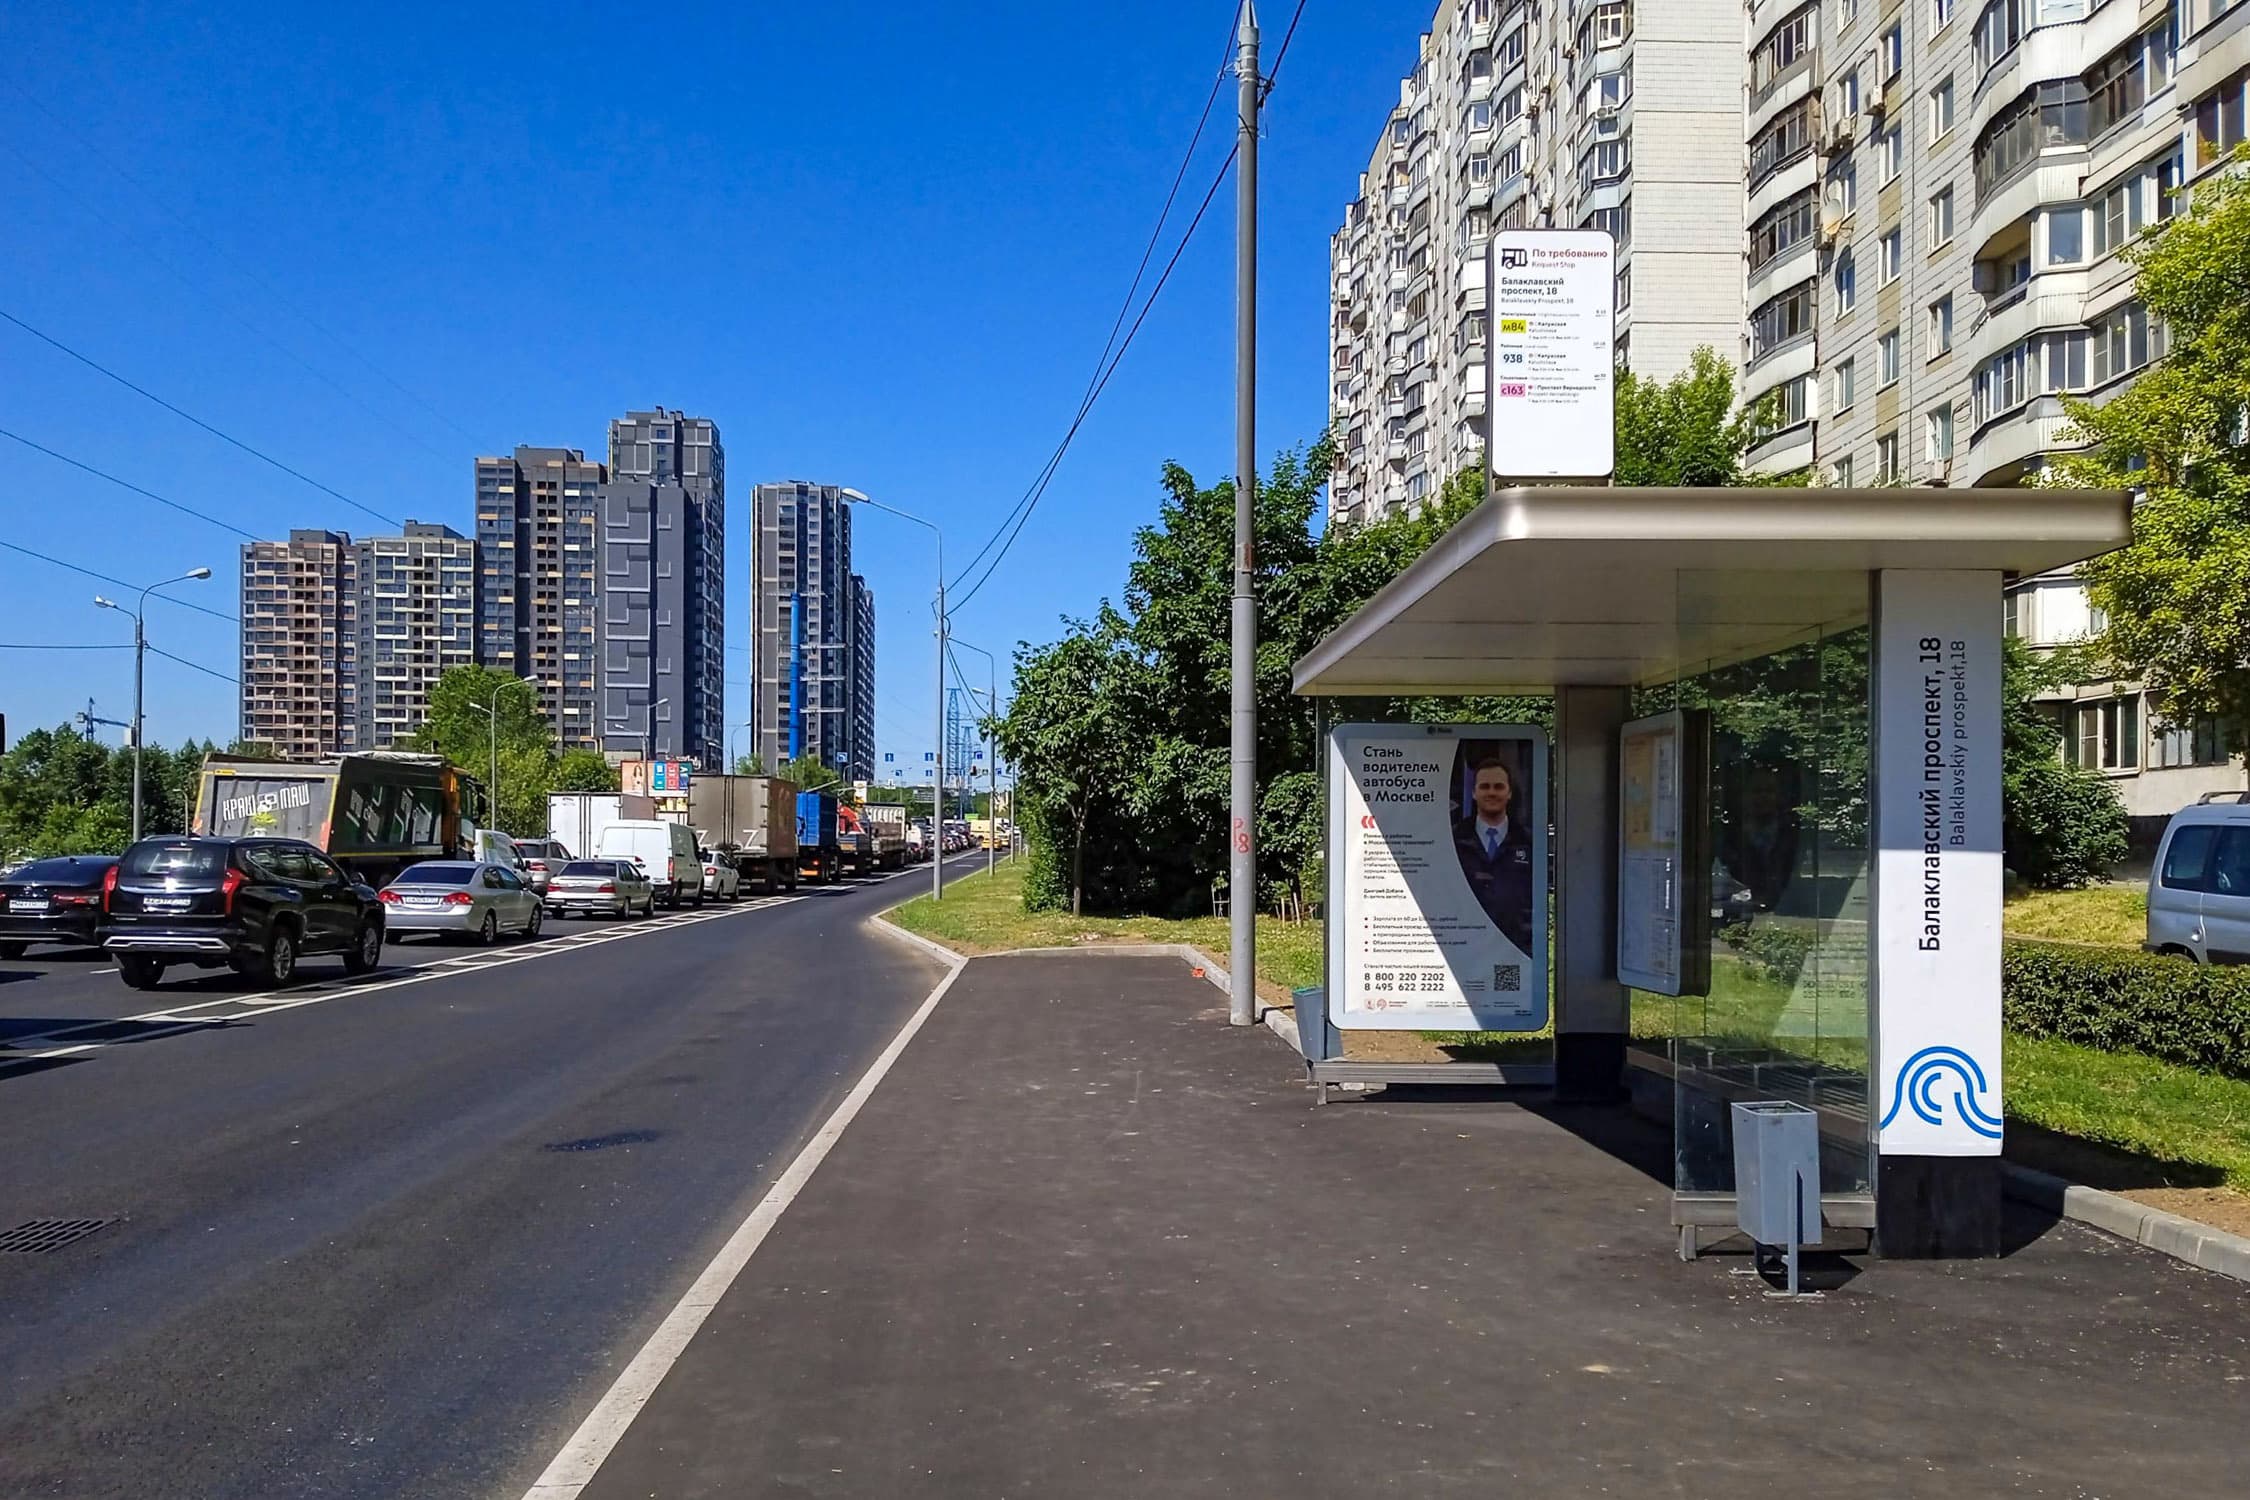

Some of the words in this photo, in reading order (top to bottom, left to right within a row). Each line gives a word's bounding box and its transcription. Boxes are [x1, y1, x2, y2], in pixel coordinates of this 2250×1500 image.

[1532, 249, 1546, 258] По
[1549, 249, 1608, 259] требованию
[1532, 261, 1559, 269] Request
[1560, 261, 1576, 269] Stop
[1501, 277, 1565, 286] Балаклавский
[1501, 287, 1545, 296] проспект,
[1546, 287, 1558, 295] 18
[1503, 322, 1525, 332] м84
[1503, 353, 1523, 364] 938
[1501, 385, 1524, 395] с163
[1919, 637, 1941, 663] 18
[1924, 670, 1946, 782] проспект,
[1363, 745, 1404, 758] Стань
[1363, 763, 1440, 774] водителем
[1363, 775, 1425, 790] автобуса
[1363, 793, 1371, 802] в
[1375, 790, 1435, 802] Москве!
[1949, 744, 1968, 846] Balaklavskiy
[1919, 789, 1941, 951] Балаклавский
[1364, 972, 1371, 981] 8
[1375, 972, 1394, 981] 800
[1399, 972, 1417, 981] 220
[1421, 972, 1445, 981] 2202
[1364, 983, 1371, 991] 8
[1375, 983, 1394, 991] 495
[1398, 983, 1416, 991] 622
[1420, 983, 1445, 991] 2222
